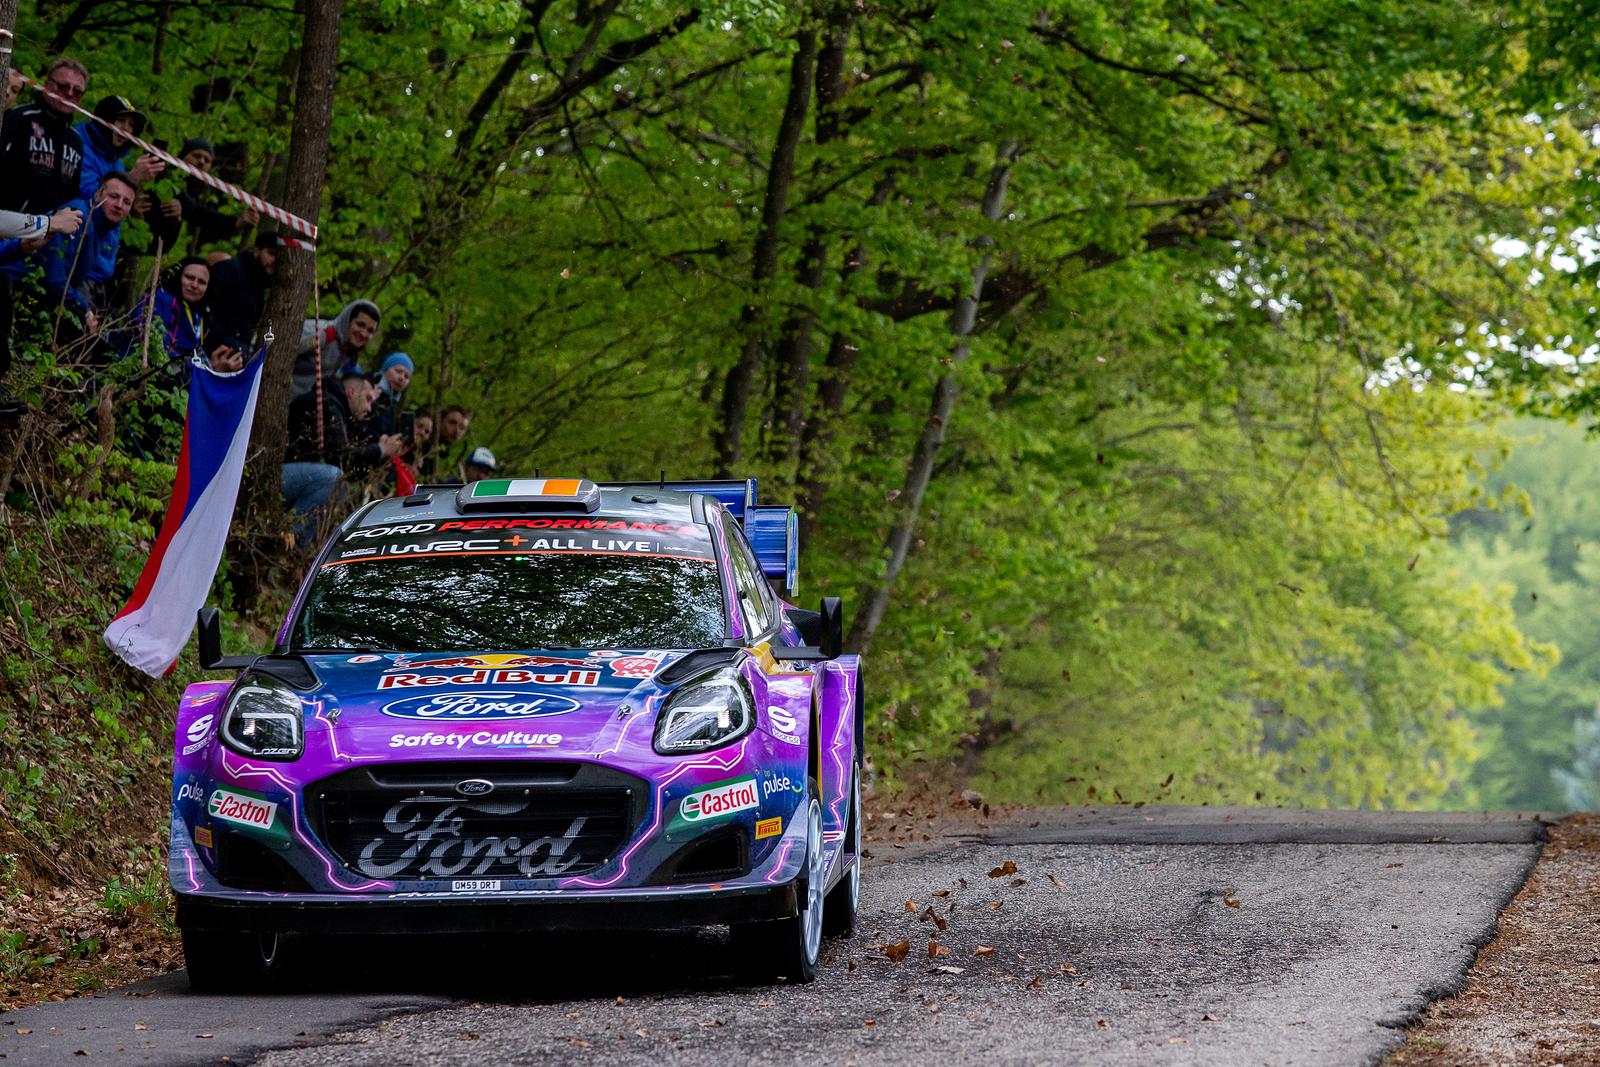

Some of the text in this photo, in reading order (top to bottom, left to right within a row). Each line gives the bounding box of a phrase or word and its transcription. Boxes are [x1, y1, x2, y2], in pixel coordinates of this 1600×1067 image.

[344, 519, 699, 542] FORD PERFORMANC
[531, 538, 584, 550] ALL
[591, 539, 651, 551] LIVE
[381, 670, 598, 688] Red Bull
[416, 693, 546, 716] Ford
[389, 731, 562, 749] SafetyCulture
[177, 783, 204, 801] pulse
[462, 782, 486, 793] Ford
[763, 774, 791, 799] pulse
[702, 784, 756, 815] Castrol
[220, 796, 271, 825] Castrol
[358, 796, 588, 878] Ford
[758, 820, 780, 836] PIRELLI
